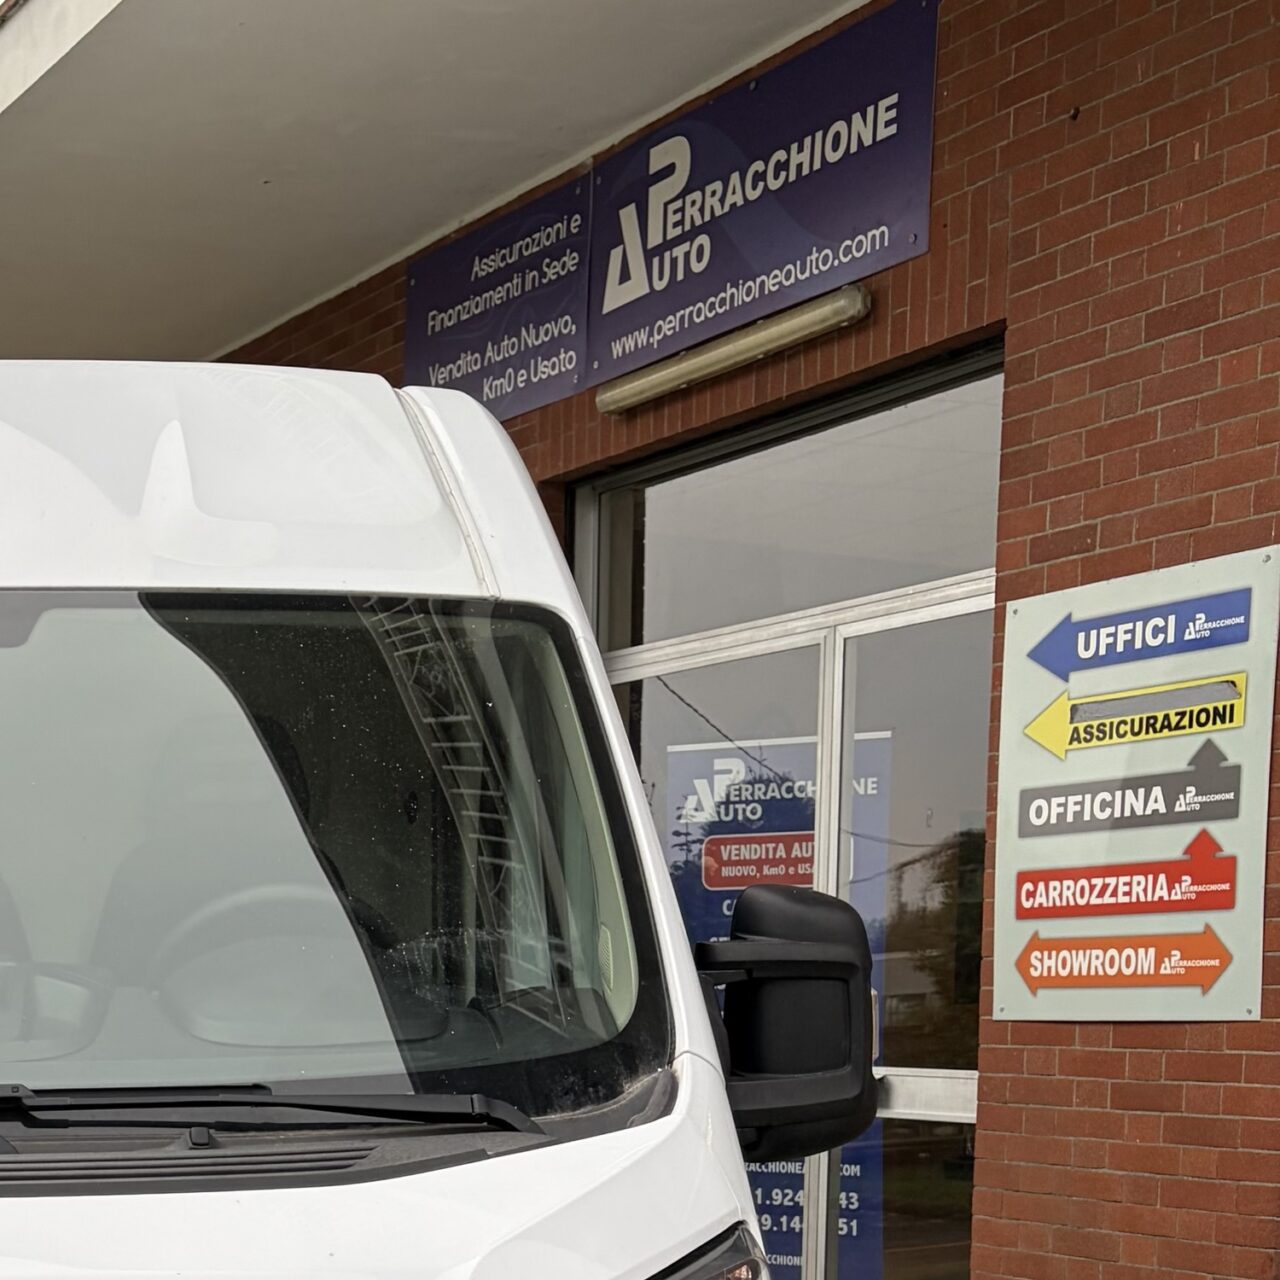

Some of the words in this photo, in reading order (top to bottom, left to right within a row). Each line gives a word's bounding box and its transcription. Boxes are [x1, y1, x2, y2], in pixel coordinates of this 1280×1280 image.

[647, 92, 900, 250] PERRACCHIONE
[471, 215, 568, 281] Assicurazioni
[570, 213, 582, 233] e
[602, 202, 712, 315] AUTO
[427, 272, 522, 336] Finanziamenti
[525, 269, 539, 292] in
[542, 249, 580, 284] Sede
[610, 225, 890, 360] www.perracchioneauto.com
[429, 349, 482, 386] Vendita
[484, 334, 519, 367] Auto
[520, 315, 577, 351] Nuovo,
[517, 372, 528, 388] e
[530, 349, 577, 383] Usato
[1077, 614, 1176, 659] UFFICI
[1184, 622, 1210, 640] AUTO
[1069, 703, 1235, 745] ASSICURAZIONI
[679, 779, 763, 823] AUTO
[1029, 786, 1167, 826] OFFICINA
[1174, 794, 1200, 812] AUTO
[720, 843, 787, 861] VENDITA
[788, 866, 795, 875] e
[1021, 873, 1169, 909] CARROZZERIA
[1169, 883, 1196, 900] AUTO
[1029, 947, 1156, 977] SHOWROOM
[1160, 957, 1185, 974] AUTO
